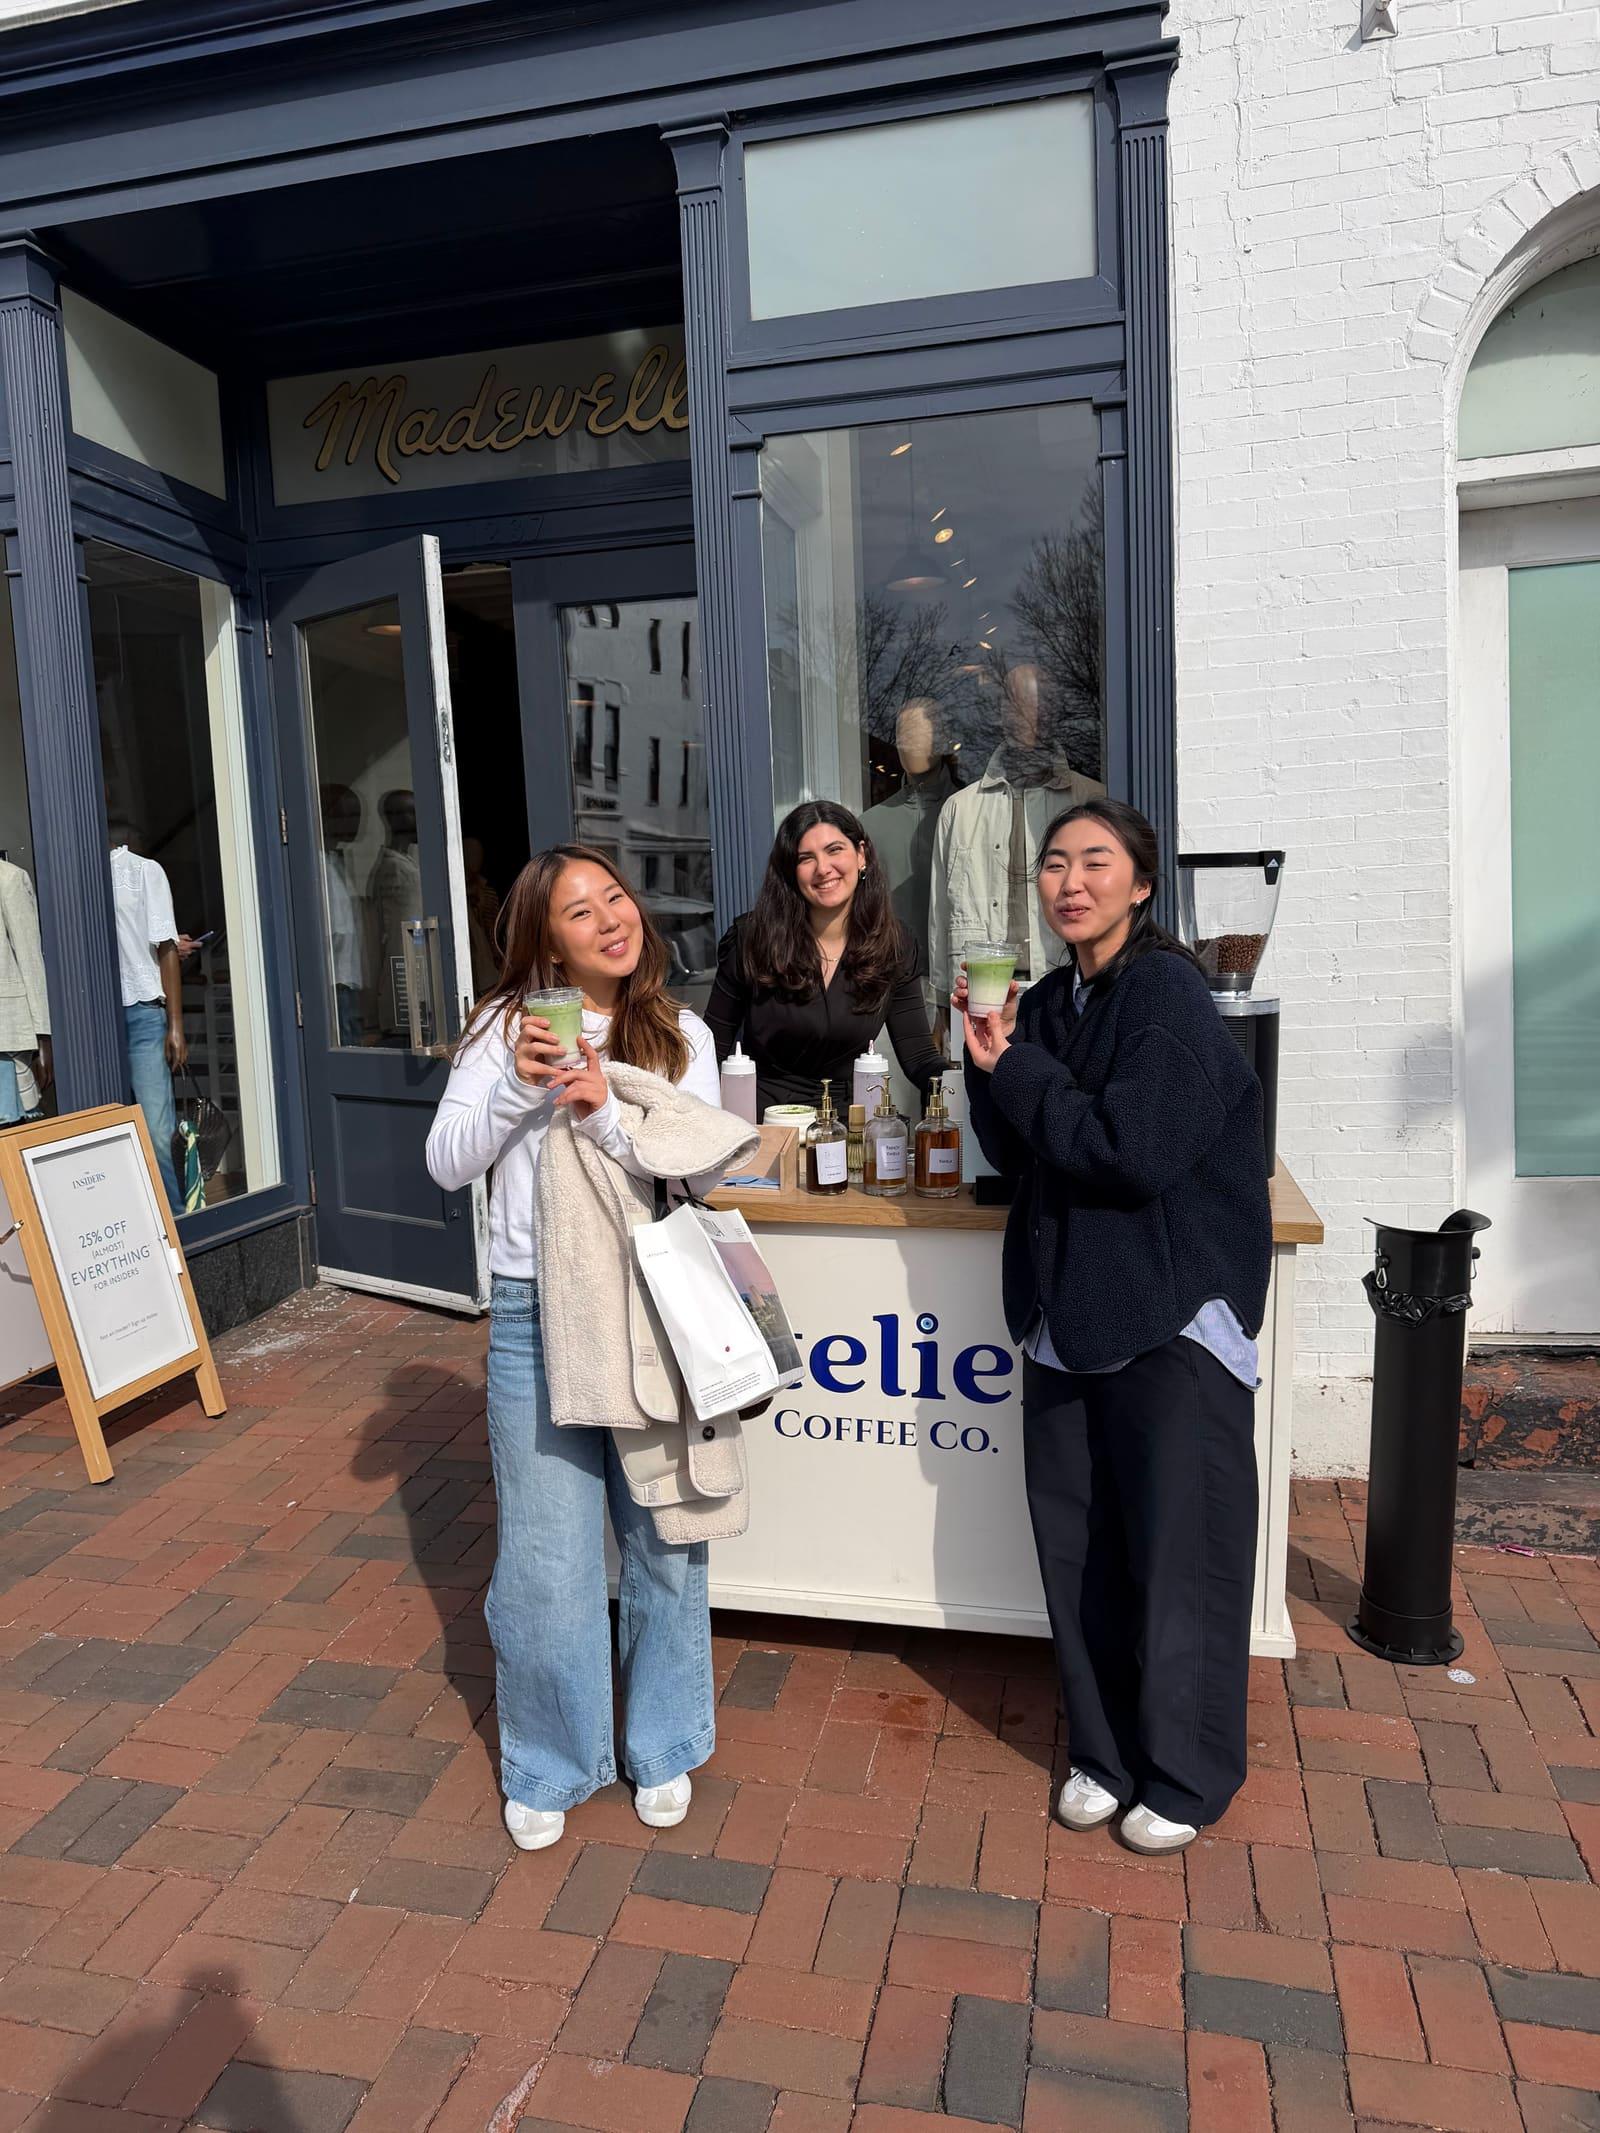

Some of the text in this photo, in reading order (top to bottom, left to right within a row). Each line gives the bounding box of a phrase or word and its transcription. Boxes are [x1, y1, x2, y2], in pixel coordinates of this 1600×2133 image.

[72, 1172, 106, 1189] INSIDERS
[79, 1220, 127, 1248] 25% OFF
[92, 1240, 125, 1259] (ALMOST)
[94, 1268, 139, 1291] FOR INSIDERS
[787, 1312, 1023, 1404] elie
[774, 1409, 918, 1447] COFFEE
